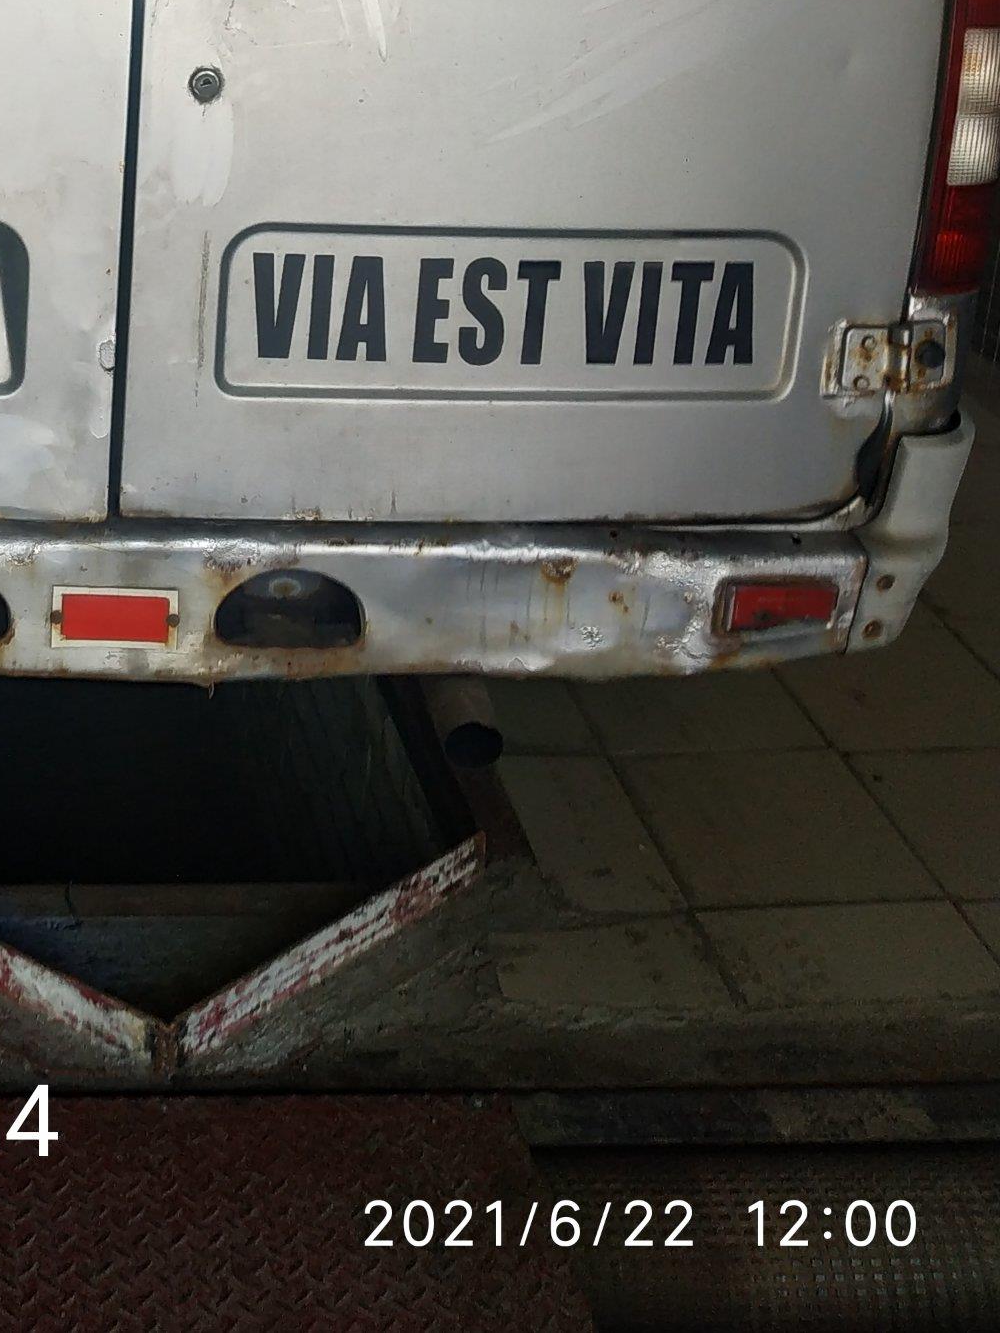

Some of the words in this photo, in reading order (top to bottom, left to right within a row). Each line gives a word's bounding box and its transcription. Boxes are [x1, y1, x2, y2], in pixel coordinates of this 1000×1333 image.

[253, 252, 387, 361] VIA
[411, 256, 561, 366] EST
[583, 259, 755, 365] VITA
